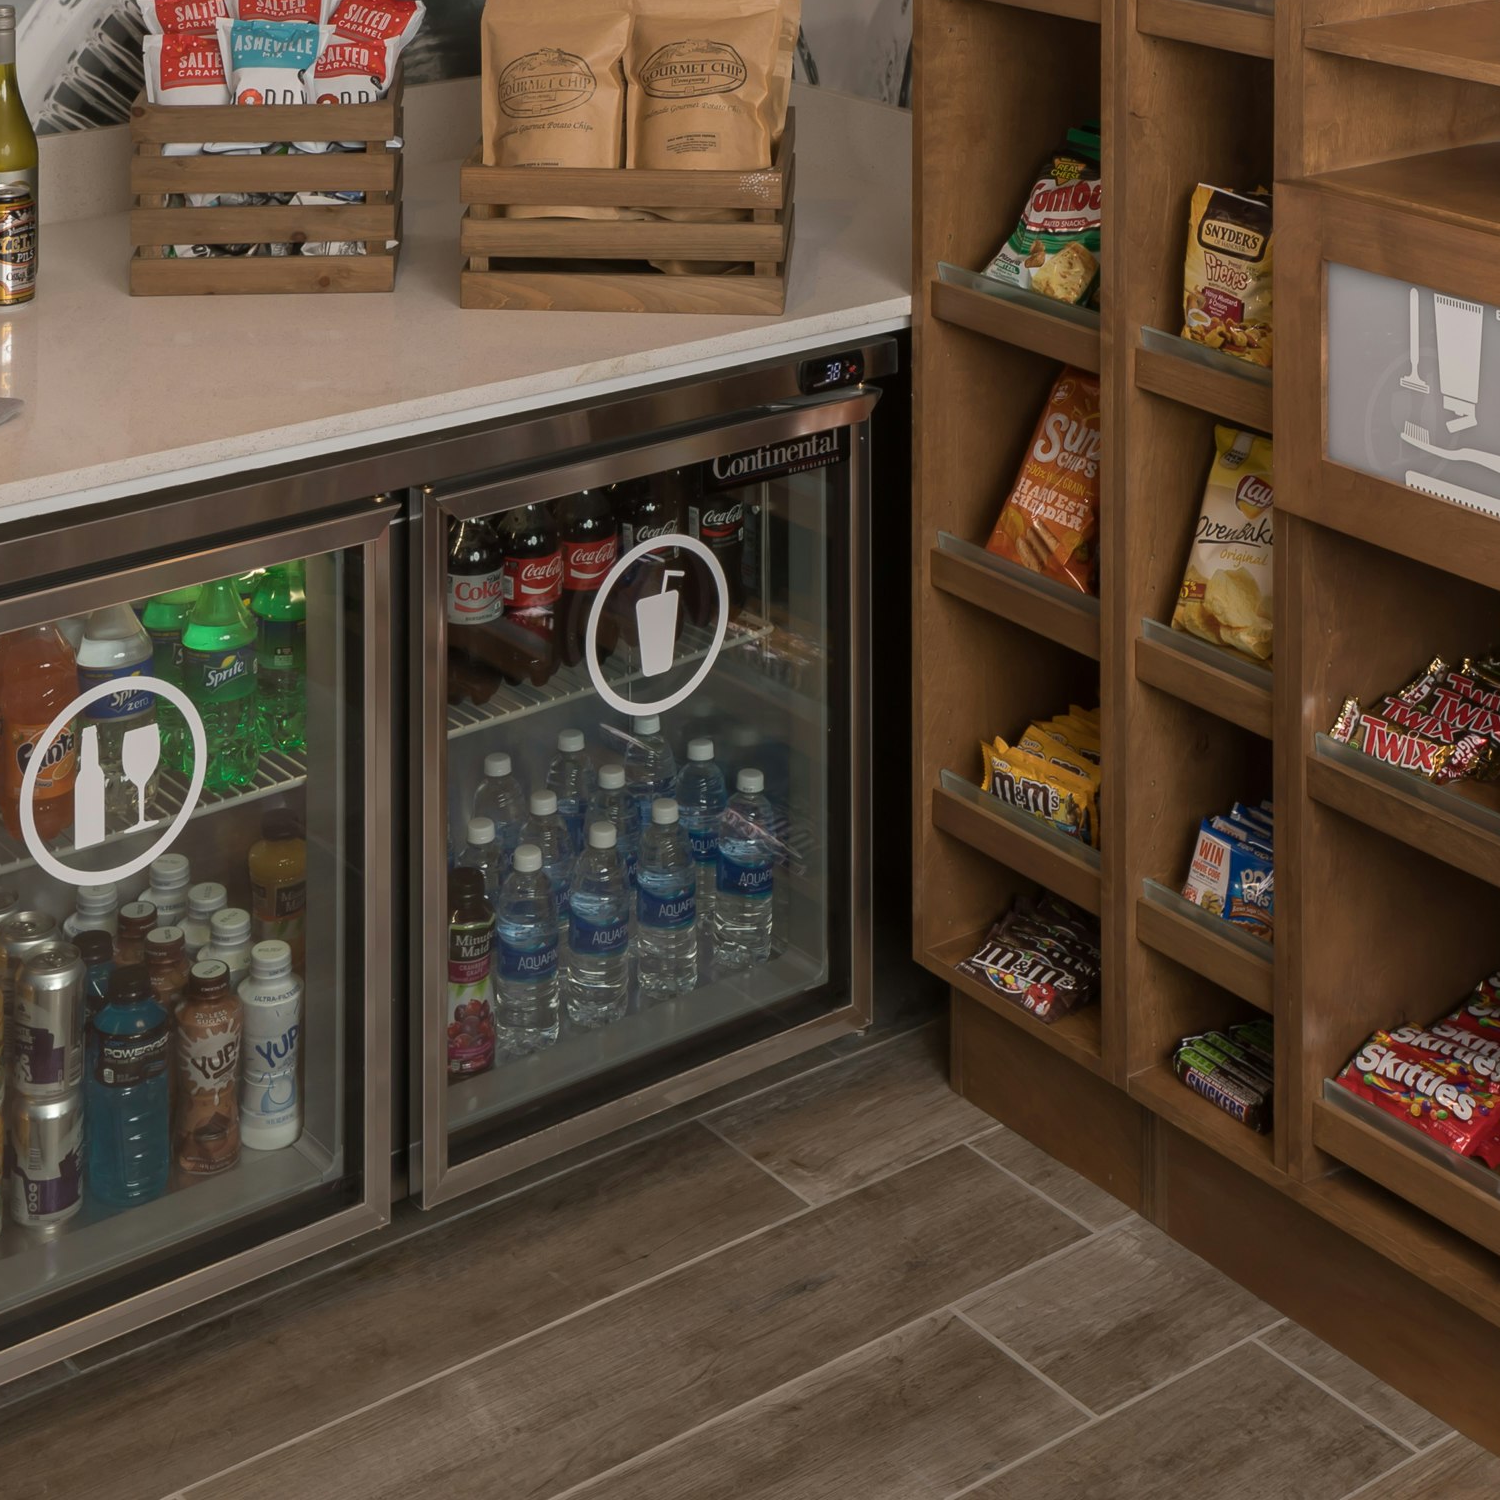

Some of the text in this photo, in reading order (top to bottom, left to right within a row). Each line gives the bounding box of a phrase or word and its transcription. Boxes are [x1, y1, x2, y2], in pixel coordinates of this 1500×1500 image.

[175, 0, 226, 23] SALTED
[255, 6, 308, 16] CARAMEL
[343, 4, 391, 30] SALTED
[338, 20, 383, 40] CARAMEL
[234, 34, 314, 55] ASHEVILLE
[643, 63, 742, 83] GOURMET CHIP
[501, 77, 591, 100] GOURMET CHIP
[1205, 223, 1259, 249] SNYDER'S
[825, 362, 842, 382] 38
[713, 428, 839, 479] Continental
[1057, 452, 1097, 478] CHIPS
[1017, 478, 1089, 516] HARVEST
[1220, 548, 1268, 567] Original
[455, 582, 499, 601] Coke
[206, 658, 244, 687] Sprite
[1199, 839, 1224, 866] WIN
[462, 943, 489, 957] Maid
[1356, 1044, 1476, 1121] Skittles
[1187, 1072, 1244, 1123] SNICKERS
